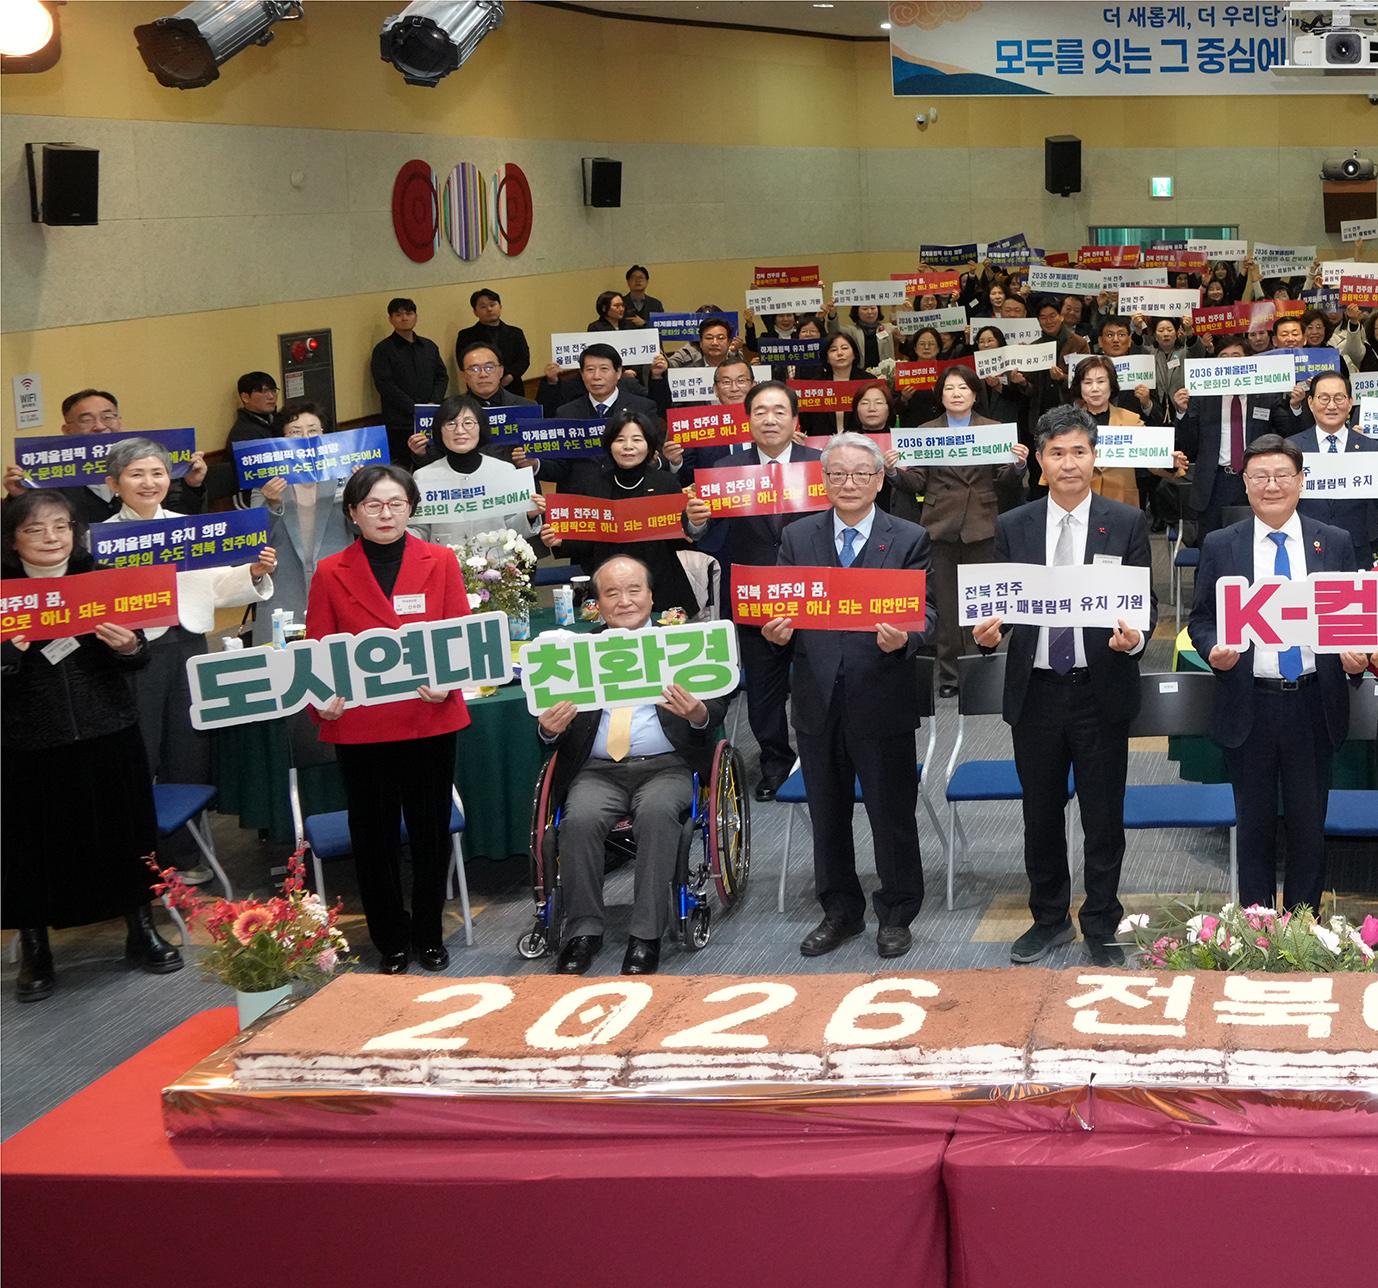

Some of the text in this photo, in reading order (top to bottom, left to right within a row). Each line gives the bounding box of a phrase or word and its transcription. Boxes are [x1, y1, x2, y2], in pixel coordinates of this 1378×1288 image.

[1104, 7, 1120, 28] 더
[1128, 7, 1192, 29] 새롭게,
[1198, 6, 1216, 27] 더
[996, 39, 1085, 75] 모두를
[1092, 39, 1152, 74] 잇는
[1160, 39, 1189, 72] 그
[1197, 38, 1286, 73] 중심에
[1190, 364, 1257, 378] 2036 하계올림픽
[1190, 373, 1290, 390] K-문화의 수도 전북에서
[20, 393, 36, 403] WIFI
[672, 415, 734, 431] 전북 전주의 꿈,
[720, 427, 737, 436] 하나
[522, 428, 565, 441] 하계올림픽
[898, 434, 975, 448] 2036 하계올림픽
[242, 450, 293, 466] 하계올림픽
[318, 443, 339, 454] 희망
[524, 440, 579, 453] K-문화의 수도
[899, 442, 1013, 460] K-문화의 수도 전북에서
[1106, 445, 1168, 458] 수도 전북에서
[22, 446, 86, 466] 하계올림픽
[244, 449, 381, 480] K-문화의 수도 전북 전주에서
[82, 460, 107, 474] 수도
[426, 486, 485, 502] 하계올림픽
[701, 477, 773, 497] 전북 전주의 꿈,
[454, 489, 530, 514] 수도 전북에서
[757, 491, 777, 503] 하나
[550, 508, 614, 520] 전북 전주의 꿈,
[601, 520, 642, 533] 하나 되는
[97, 532, 165, 555] 하계올림픽
[202, 522, 227, 537] 희망
[160, 531, 267, 561] 수도 전북 전주에서
[46, 592, 65, 607] 꿈,
[737, 582, 827, 599] 전북 전주의 꿈,
[965, 582, 1022, 600] 전북 전주
[40, 592, 171, 625] 하나 되는 대한민국
[737, 596, 919, 616] 올림픽으로 하나 되는 대한민국
[966, 594, 1142, 618] 올림픽·패럴림픽 유치 기원
[197, 618, 505, 722] 도시연대
[527, 628, 732, 708] 친환경
[362, 978, 941, 1052] 2026
